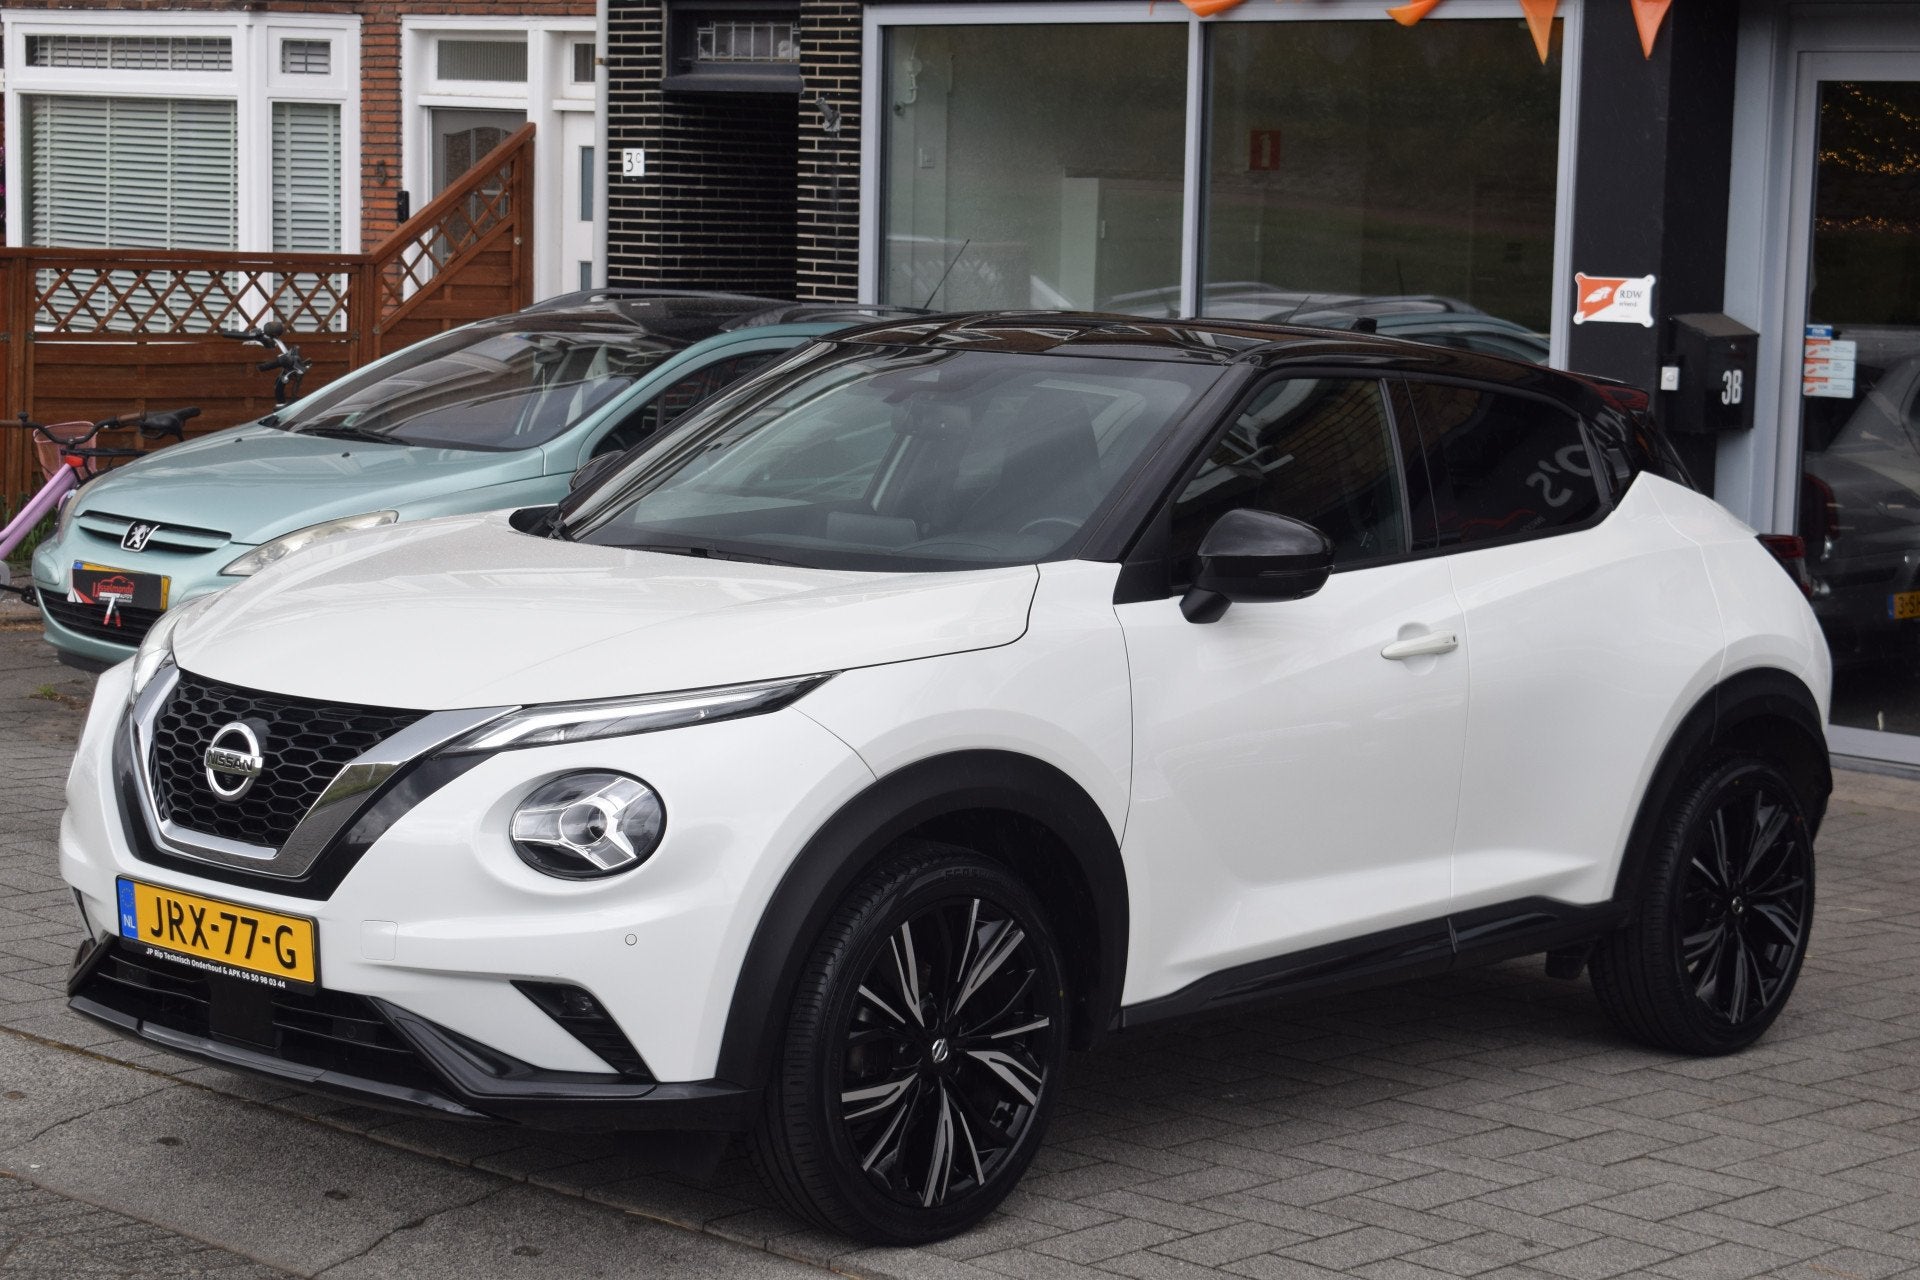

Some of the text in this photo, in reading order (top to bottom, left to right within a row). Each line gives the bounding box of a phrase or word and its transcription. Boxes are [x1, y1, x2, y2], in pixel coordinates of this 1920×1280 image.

[1619, 289, 1643, 299] RDW
[1721, 369, 1743, 405] 3B
[207, 749, 256, 772] NISSAN
[123, 914, 136, 929] NL
[150, 896, 297, 970] JRX-77-G
[146, 947, 286, 989] JP Rip Technisch Onderhoud & APK 06 50 98 03 44
